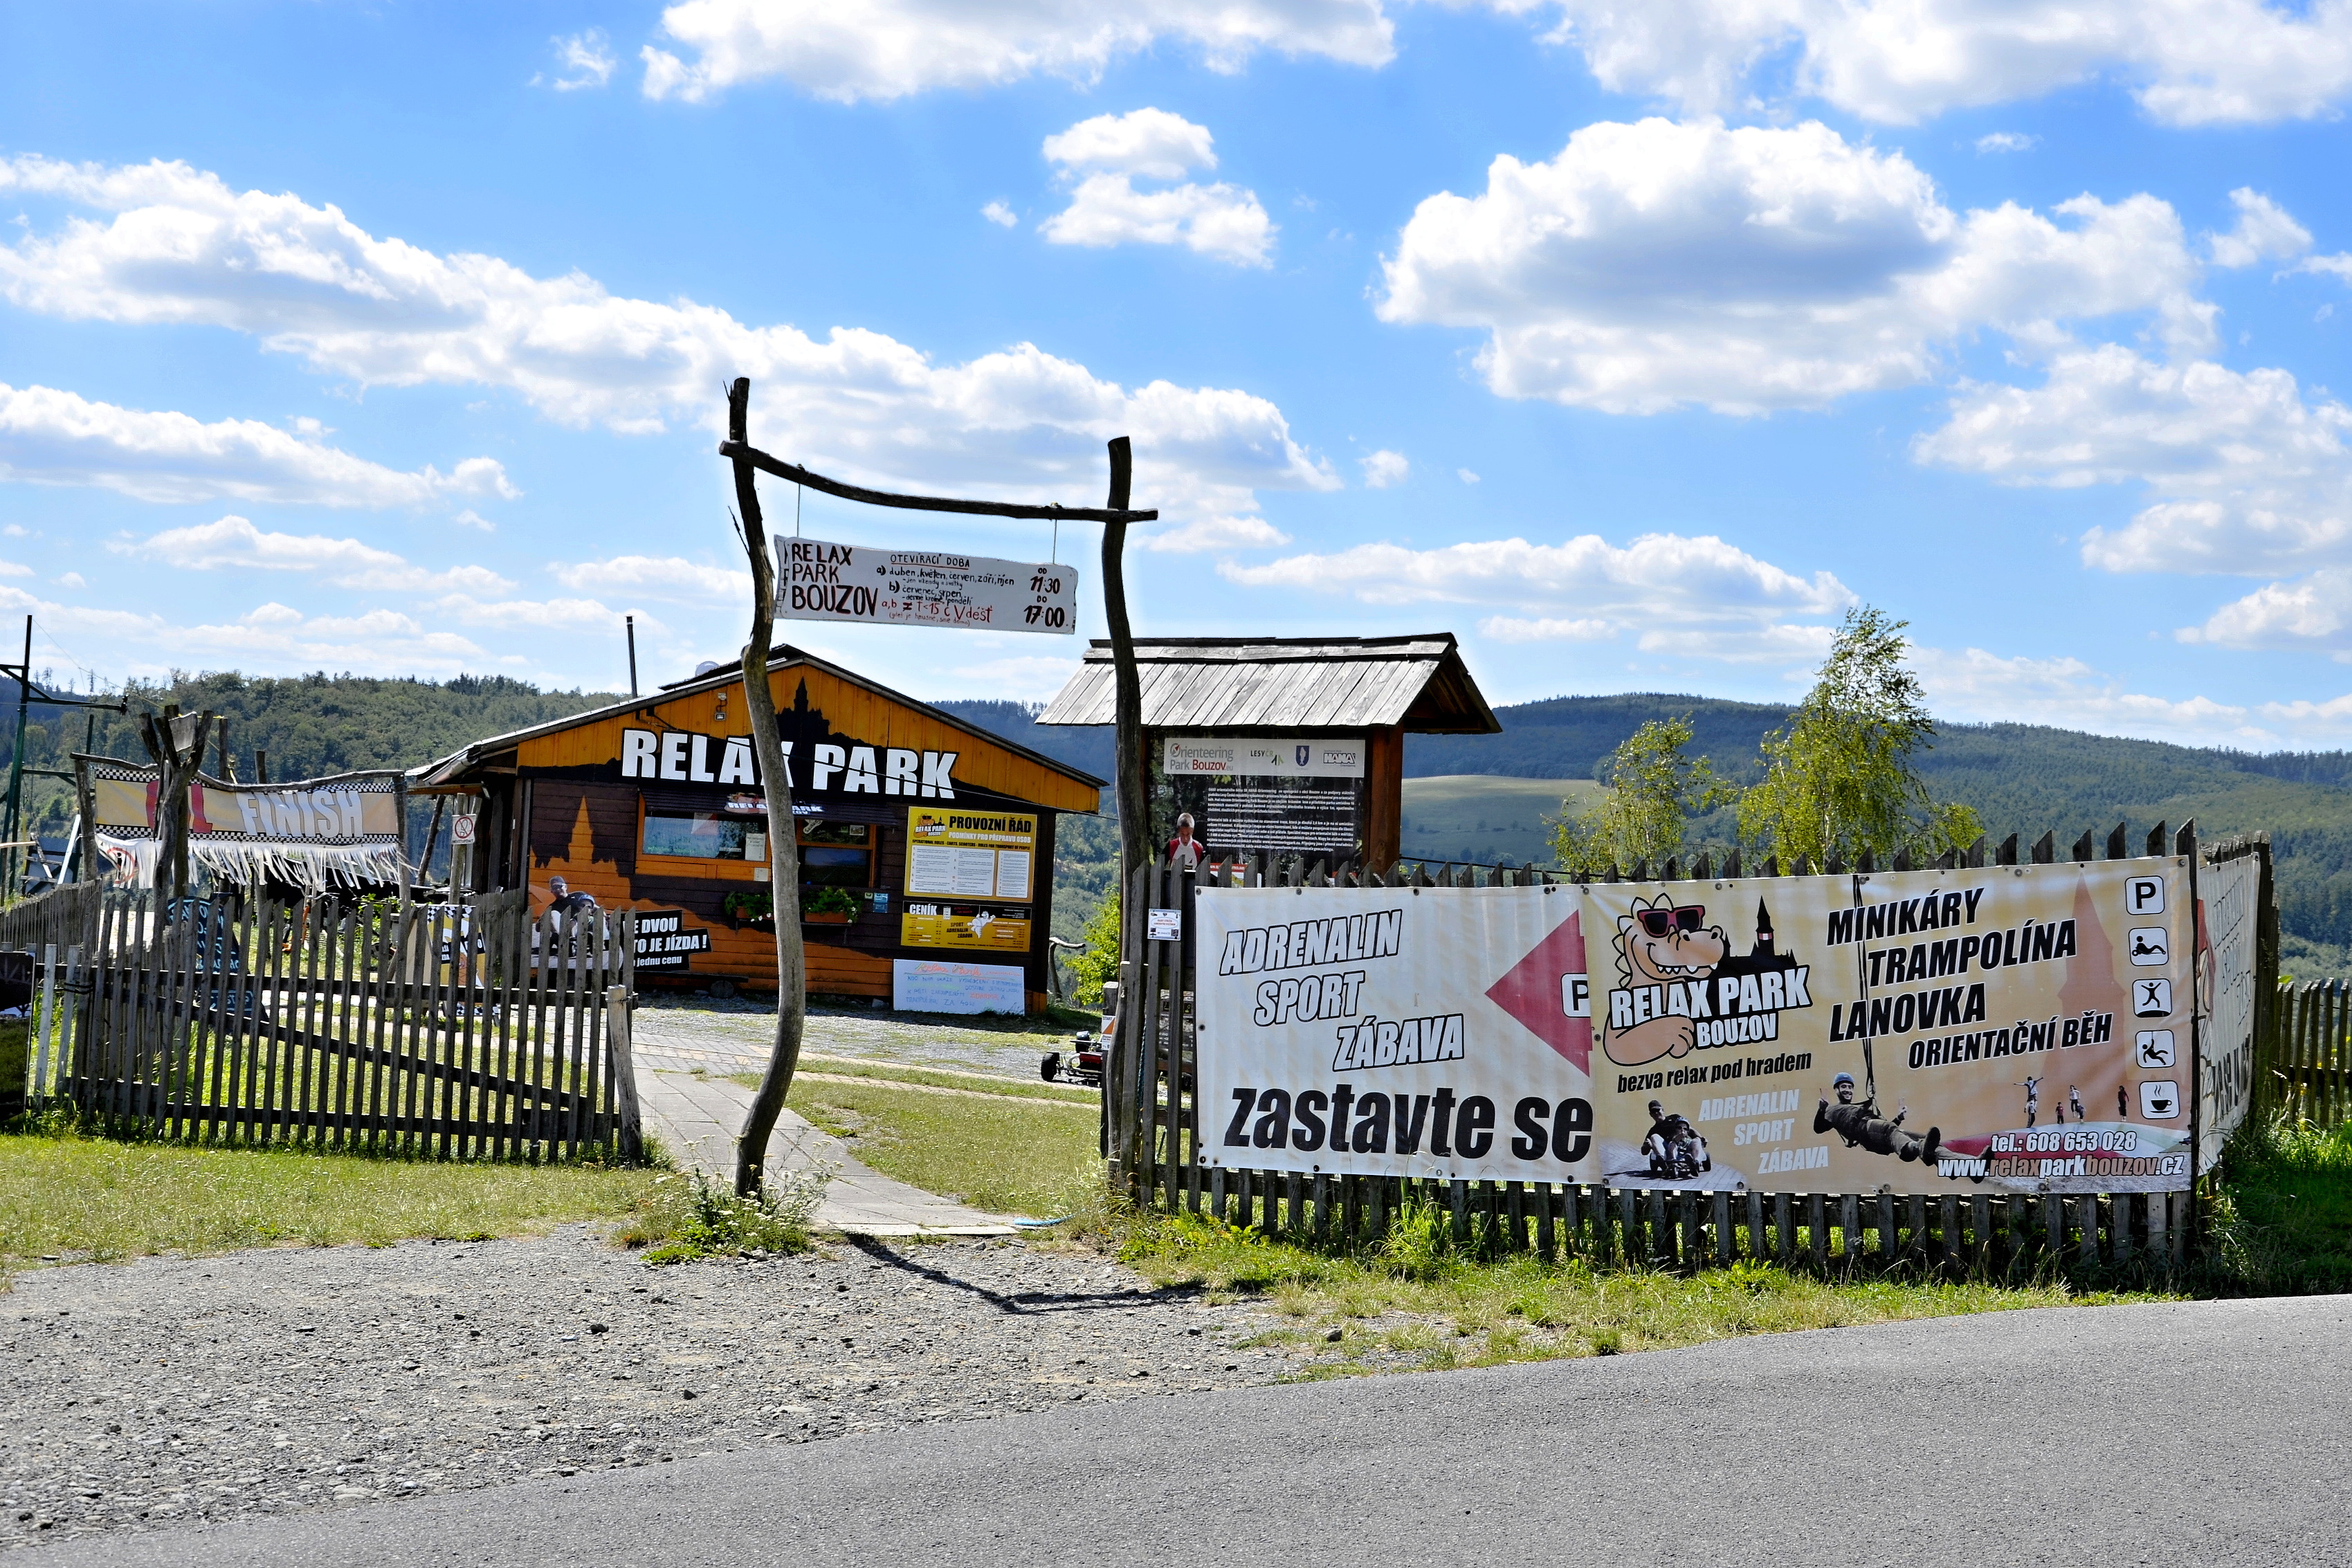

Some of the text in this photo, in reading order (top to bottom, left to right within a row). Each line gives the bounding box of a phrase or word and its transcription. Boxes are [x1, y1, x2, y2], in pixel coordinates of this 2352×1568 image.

[792, 543, 852, 566] RELAX
[891, 553, 970, 568] OTEVÍRACÍ DOBA
[792, 563, 839, 583] PARK
[876, 565, 886, 576] a)
[889, 581, 900, 593] b)
[1030, 576, 1060, 594] 11:30
[792, 584, 878, 617] BOUZOV
[1023, 605, 1065, 628] 17:00
[812, 743, 958, 799] PARK
[1170, 760, 1189, 771] Park
[235, 790, 364, 839] FINISH
[949, 815, 1032, 833] PROVOZNÍ ŘÁD
[949, 832, 977, 840] PODMÍNKY
[989, 833, 1016, 842] PŘEPRAVU
[909, 904, 938, 916] CENÍK
[1827, 887, 1985, 946] MINIKÁRY
[641, 918, 678, 933] DVOU
[649, 938, 662, 952] JE
[664, 934, 700, 951] JÍZDA
[1219, 909, 1403, 976] ADRENALIN
[1868, 918, 2076, 988] TRAMPOLÍNA
[637, 956, 682, 967] jednu cenu
[1254, 970, 1365, 1027] SPORT
[1611, 967, 1811, 1028] RELAX PARK
[1828, 983, 1985, 1043] LANOVKA
[1333, 1013, 1464, 1072] ZÁBAVA
[1697, 1013, 1777, 1048] BOUZOV
[1908, 1009, 2114, 1070] ORIENTAČNÍ BĚH
[1617, 1052, 1812, 1093] bezva relax pod hradem
[1698, 1089, 1799, 1122] ADRENALIN
[1223, 1084, 1594, 1164] zastavte se
[1733, 1118, 1795, 1146] SPORT
[1991, 1130, 2137, 1153] tel.: 608 653 028
[1758, 1145, 1829, 1174] ZÁBAVA
[1938, 1155, 2184, 1178] www.relaxparkbouzov.cz
